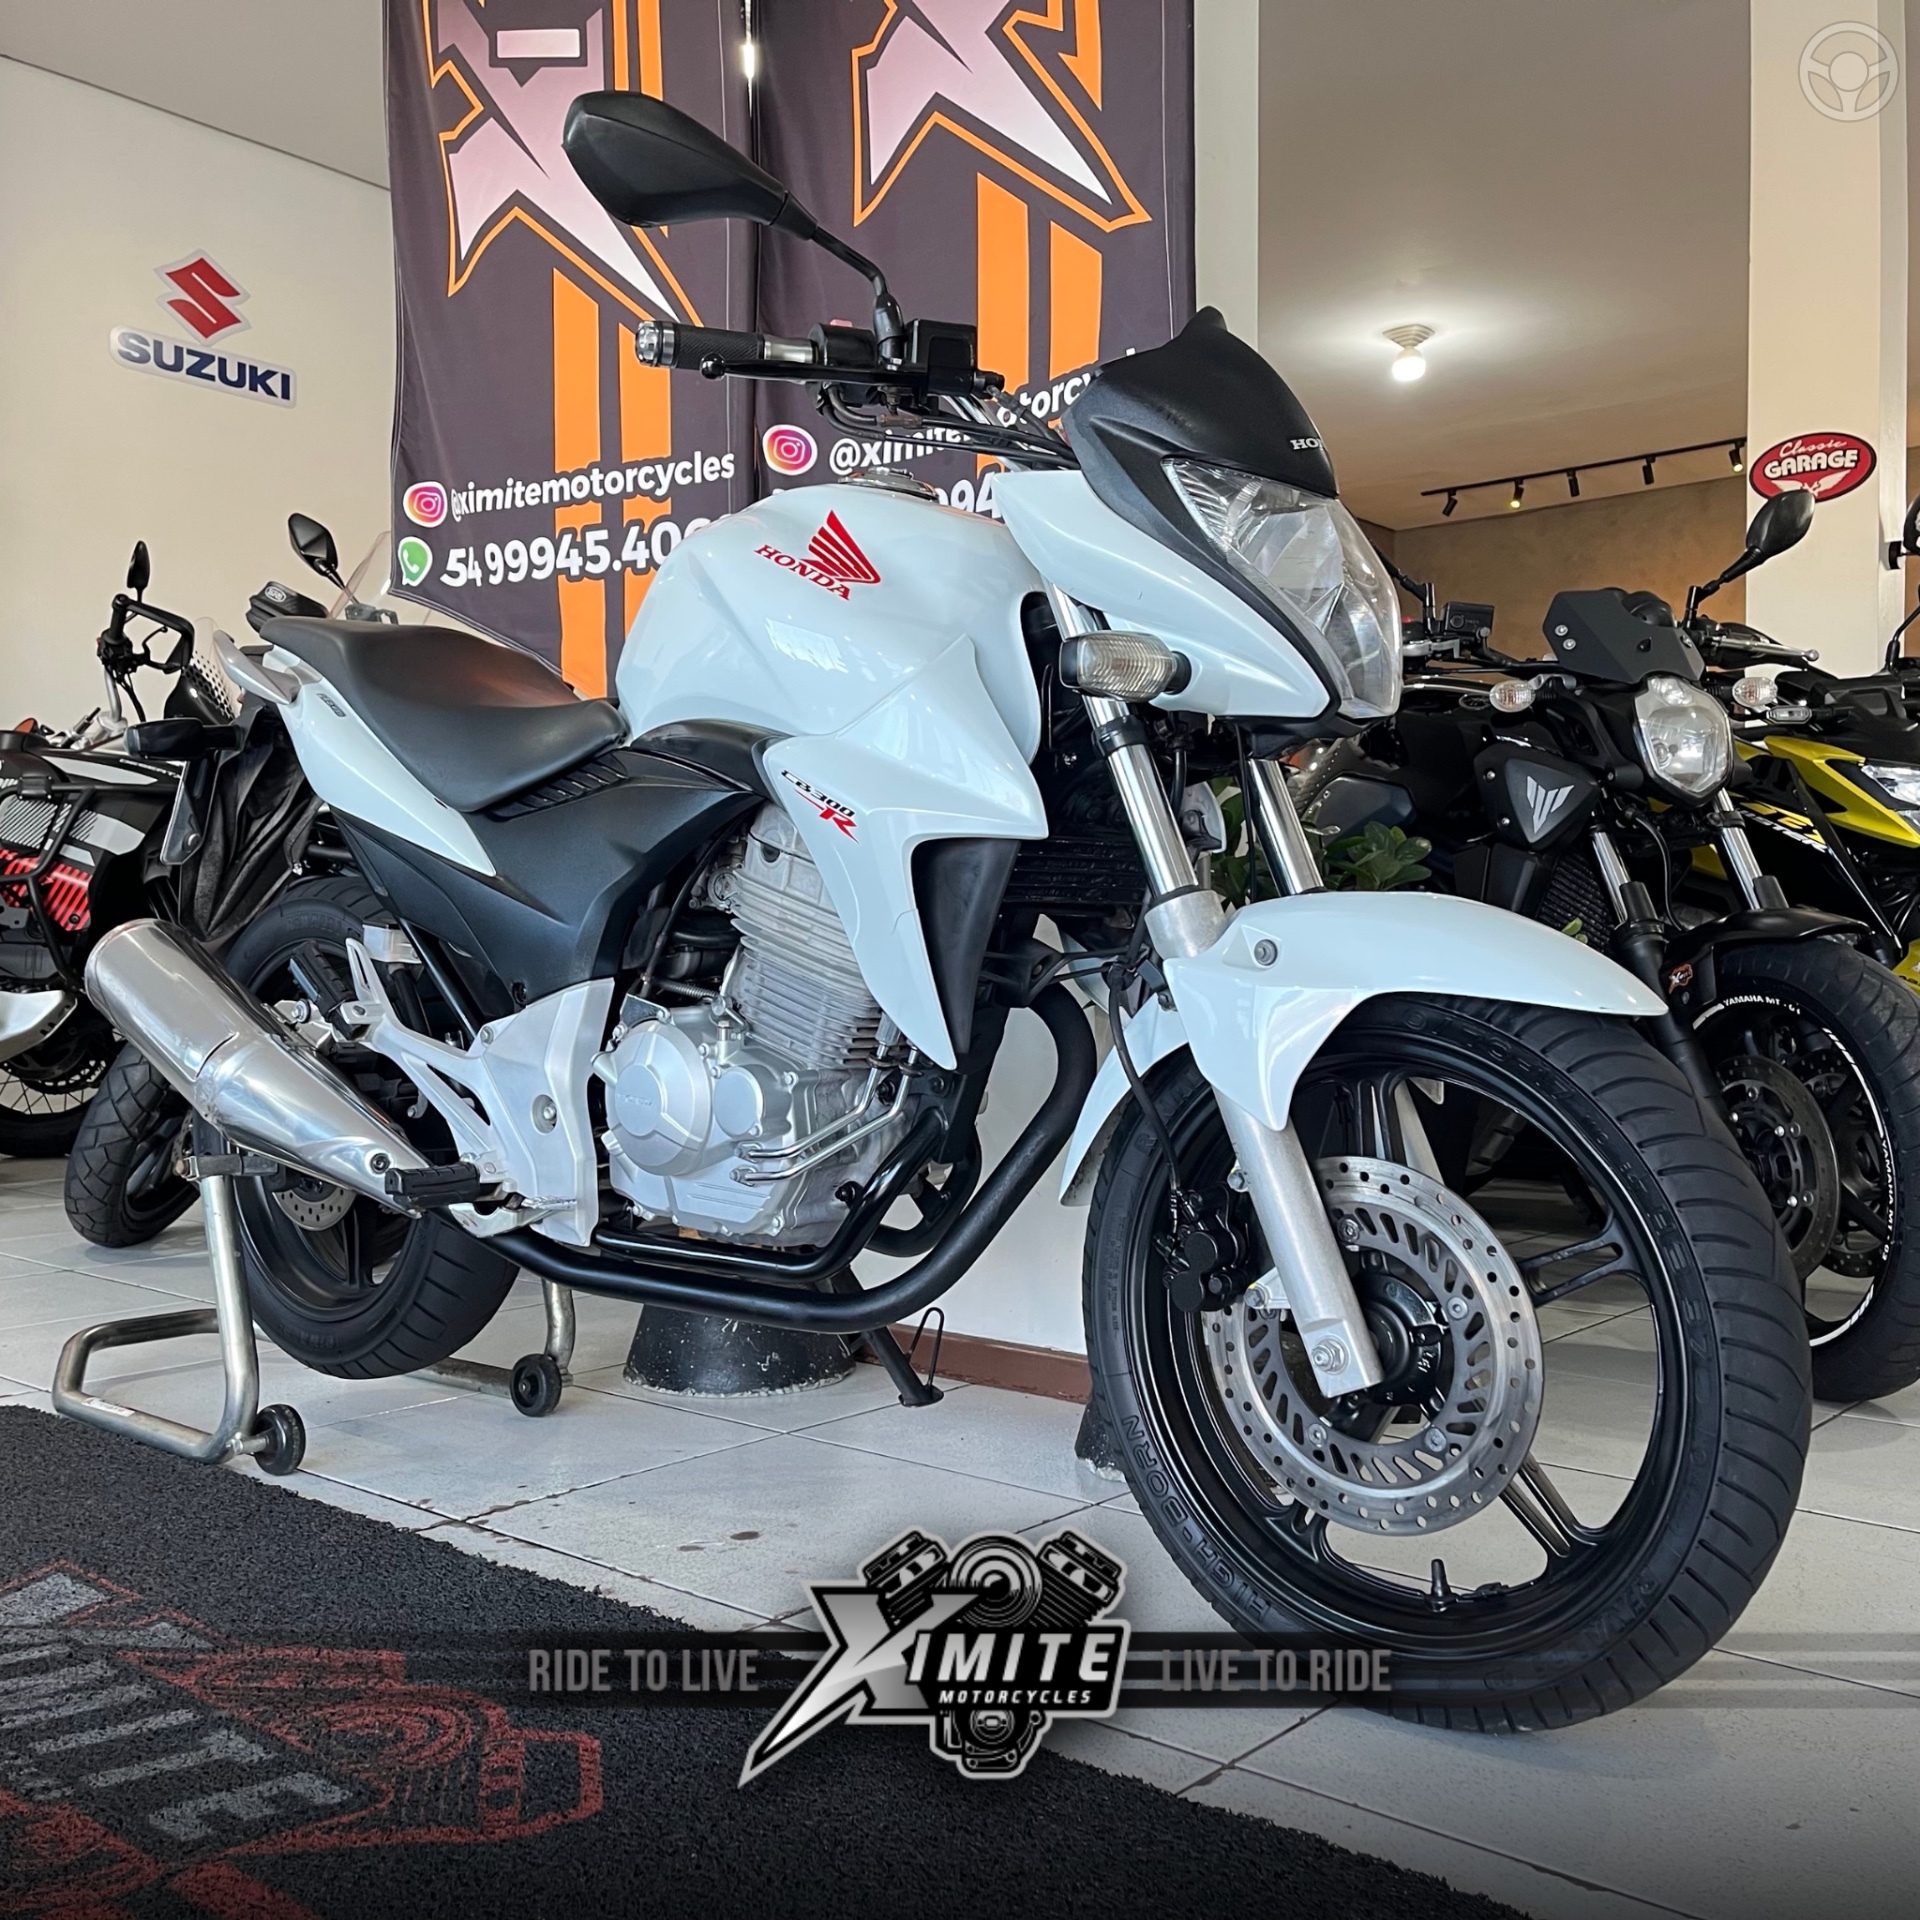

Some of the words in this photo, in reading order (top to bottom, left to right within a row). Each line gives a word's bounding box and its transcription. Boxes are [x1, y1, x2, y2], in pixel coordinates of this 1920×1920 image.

[117, 331, 291, 401] SUZUKI
[1764, 449, 1858, 479] GARAGE
[1780, 439, 1848, 458] Classic
[451, 451, 735, 522] @ximitemotorcycles
[754, 544, 850, 601] HONDA
[1723, 995, 1764, 1006] YAMAHA
[1882, 1139, 1894, 1204] YAMAHA
